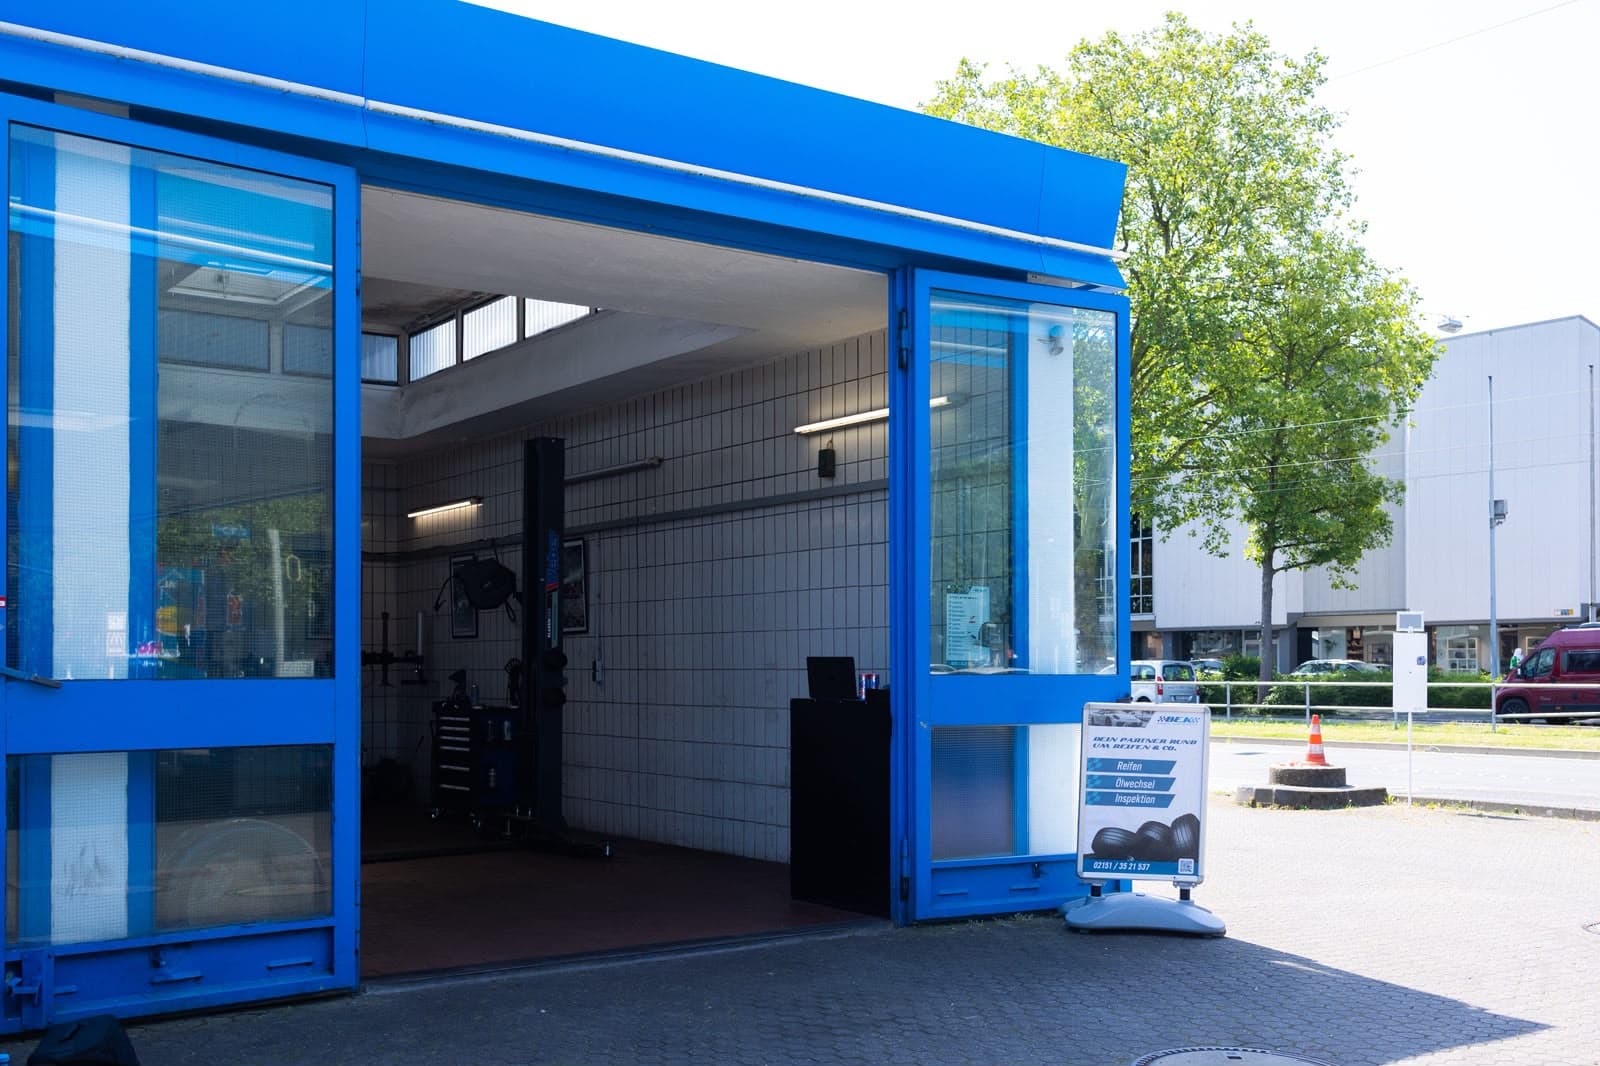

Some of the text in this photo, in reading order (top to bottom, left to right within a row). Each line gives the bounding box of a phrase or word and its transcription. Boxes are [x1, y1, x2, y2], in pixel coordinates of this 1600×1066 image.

[1117, 761, 1142, 771] Reifen
[1115, 777, 1156, 789] Ölwechsel
[1115, 793, 1156, 805] Inspektion
[1093, 861, 1112, 870] 02151
[1118, 862, 1127, 870] 35
[1137, 863, 1150, 871] 537
